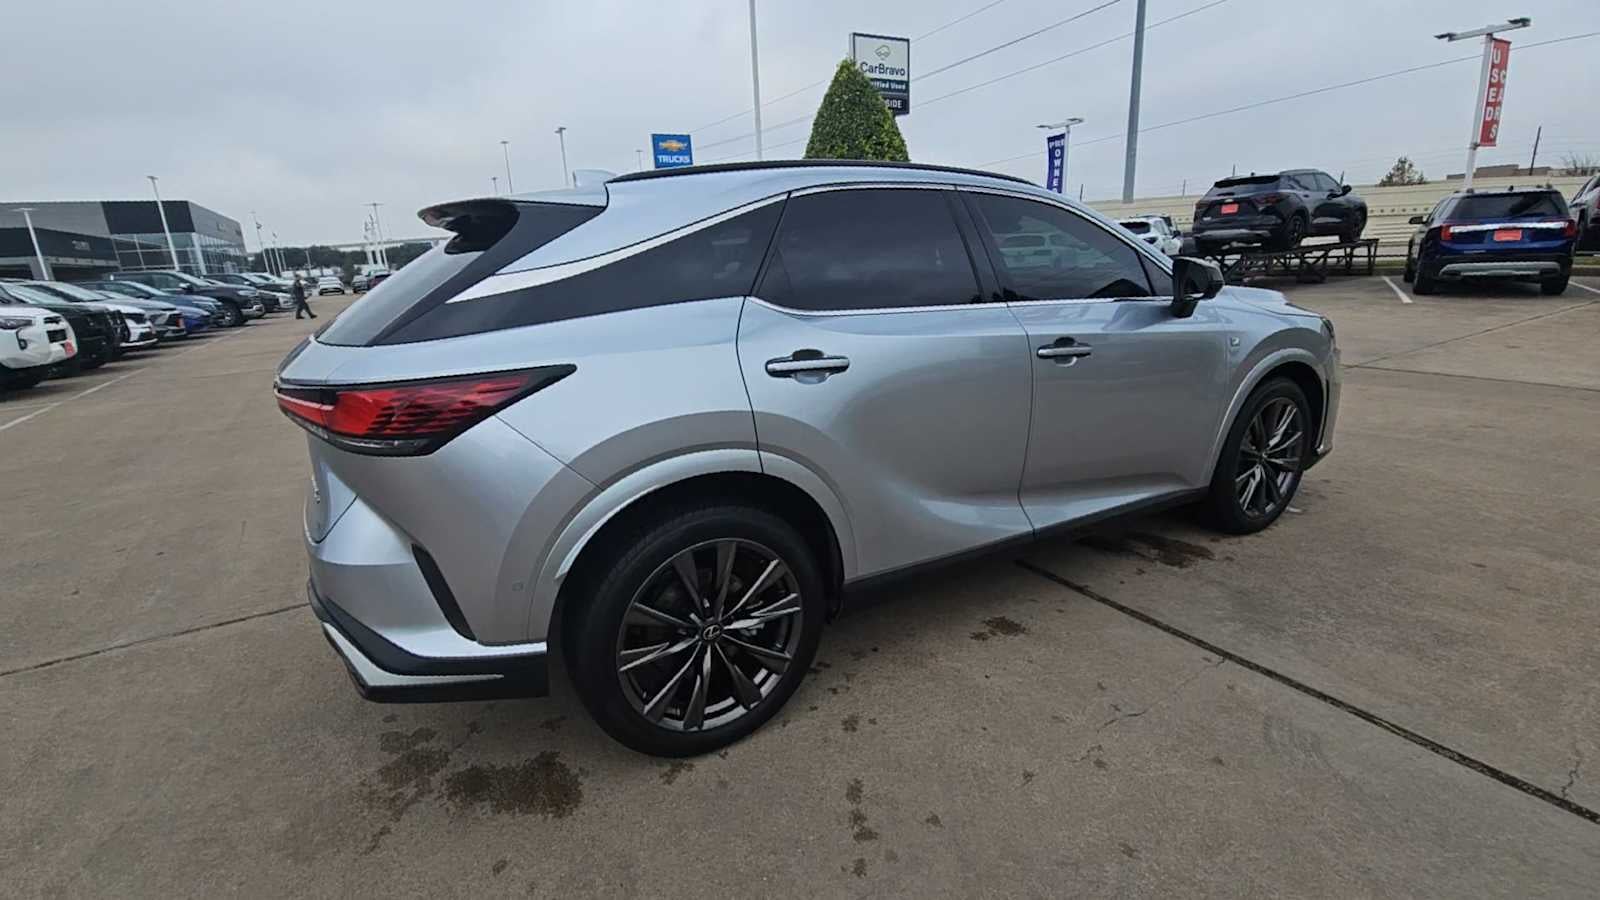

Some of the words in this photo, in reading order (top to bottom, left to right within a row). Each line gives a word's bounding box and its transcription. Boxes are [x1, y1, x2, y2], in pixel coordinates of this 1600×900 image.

[859, 61, 906, 77] CarBravo
[1485, 47, 1501, 121] USED
[657, 155, 691, 164] TRUCKS
